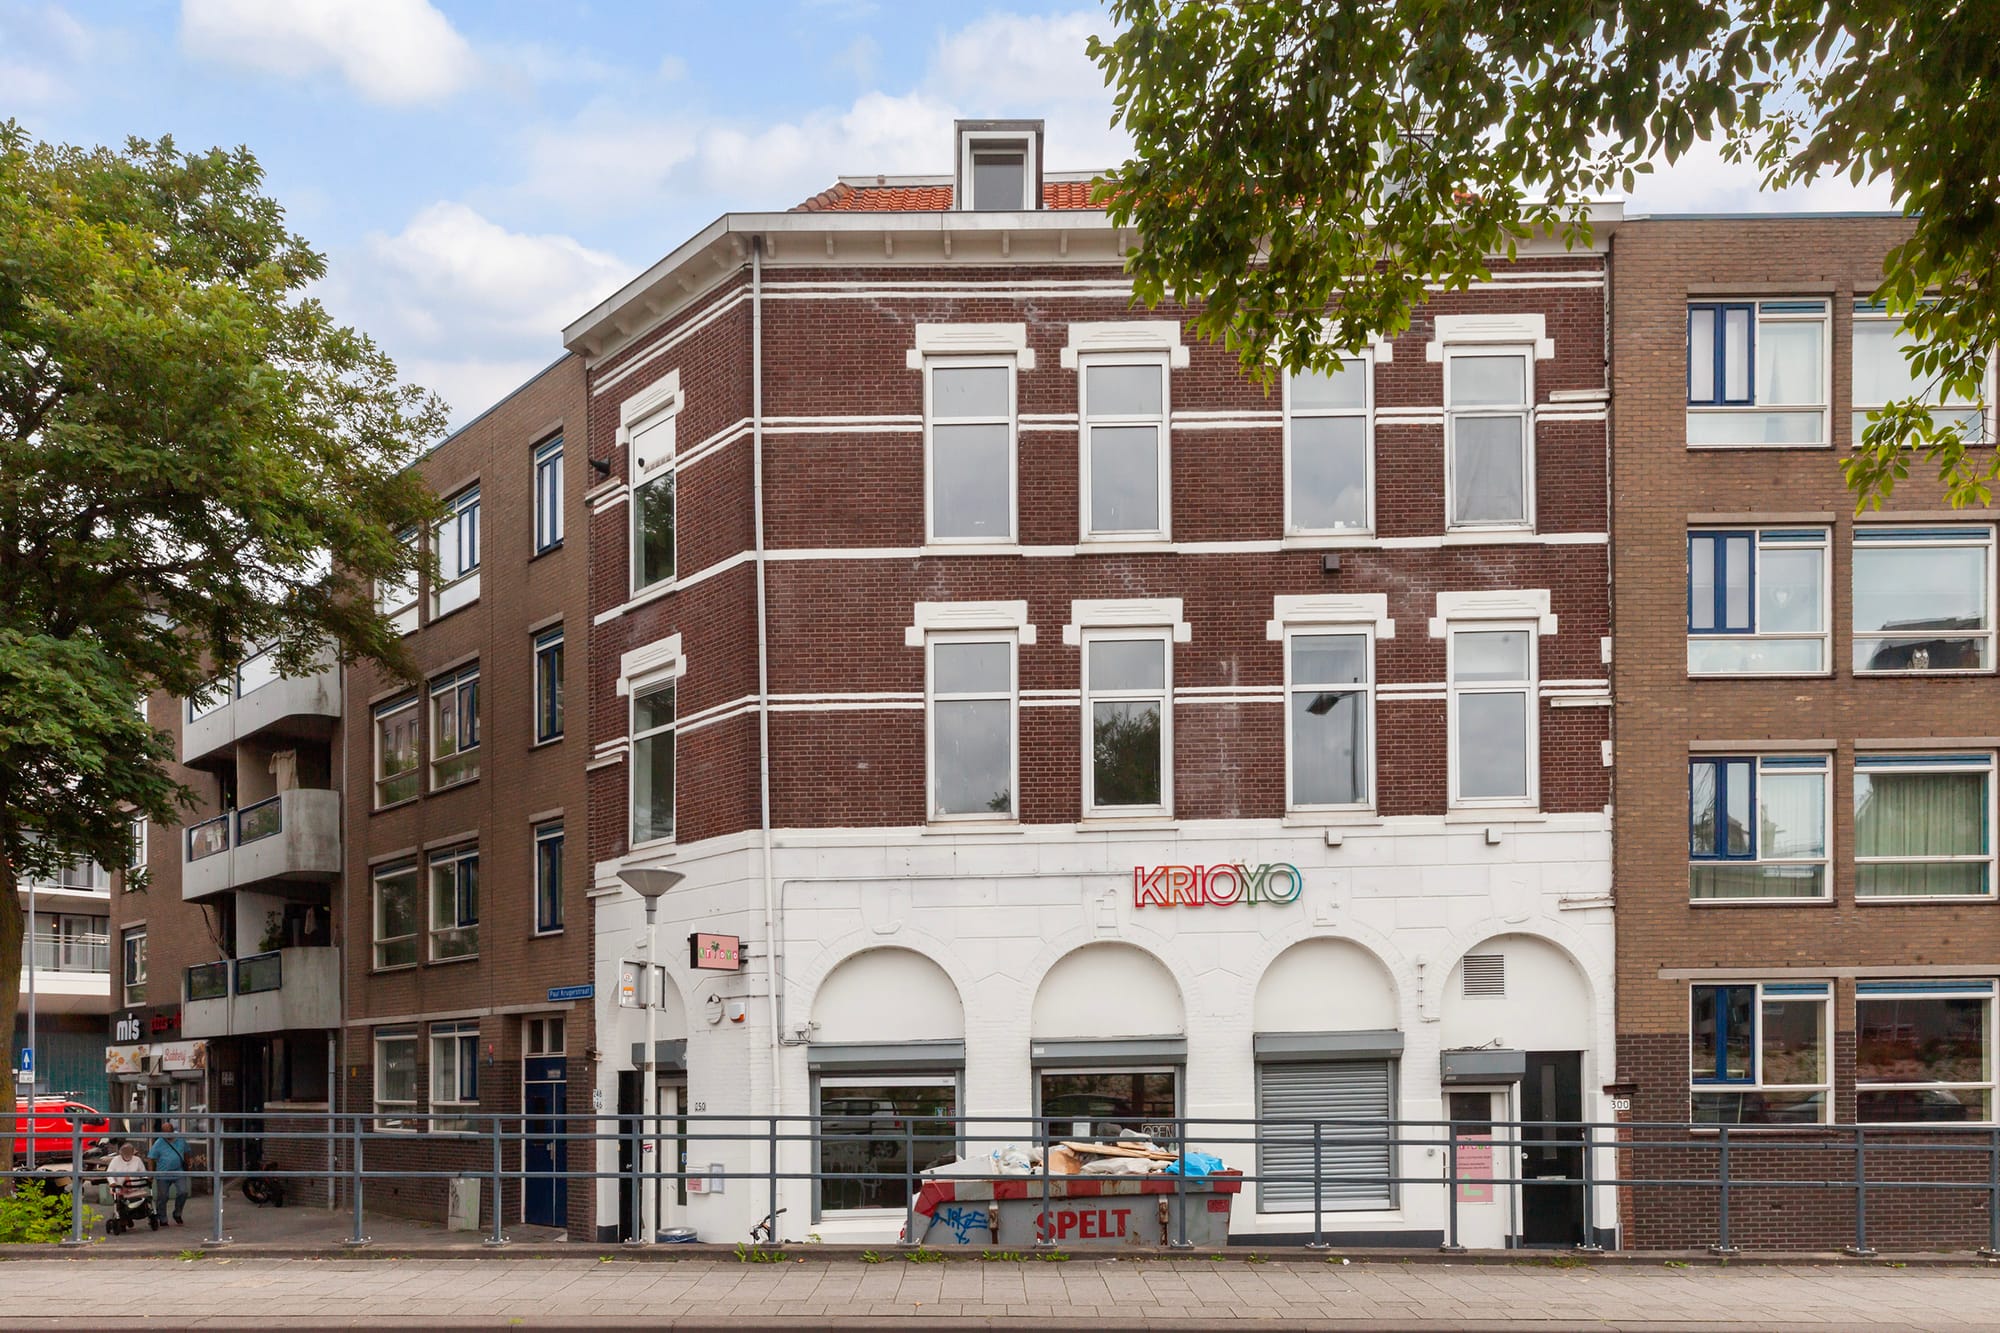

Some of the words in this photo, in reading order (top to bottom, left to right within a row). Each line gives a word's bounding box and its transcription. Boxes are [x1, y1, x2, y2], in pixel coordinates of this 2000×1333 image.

[1134, 862, 1303, 908] KRIOYO
[116, 1012, 140, 1041] mis
[1611, 1100, 1629, 1109] 300
[1143, 1125, 1175, 1138] OPEN
[1036, 1208, 1132, 1242] SPELT
